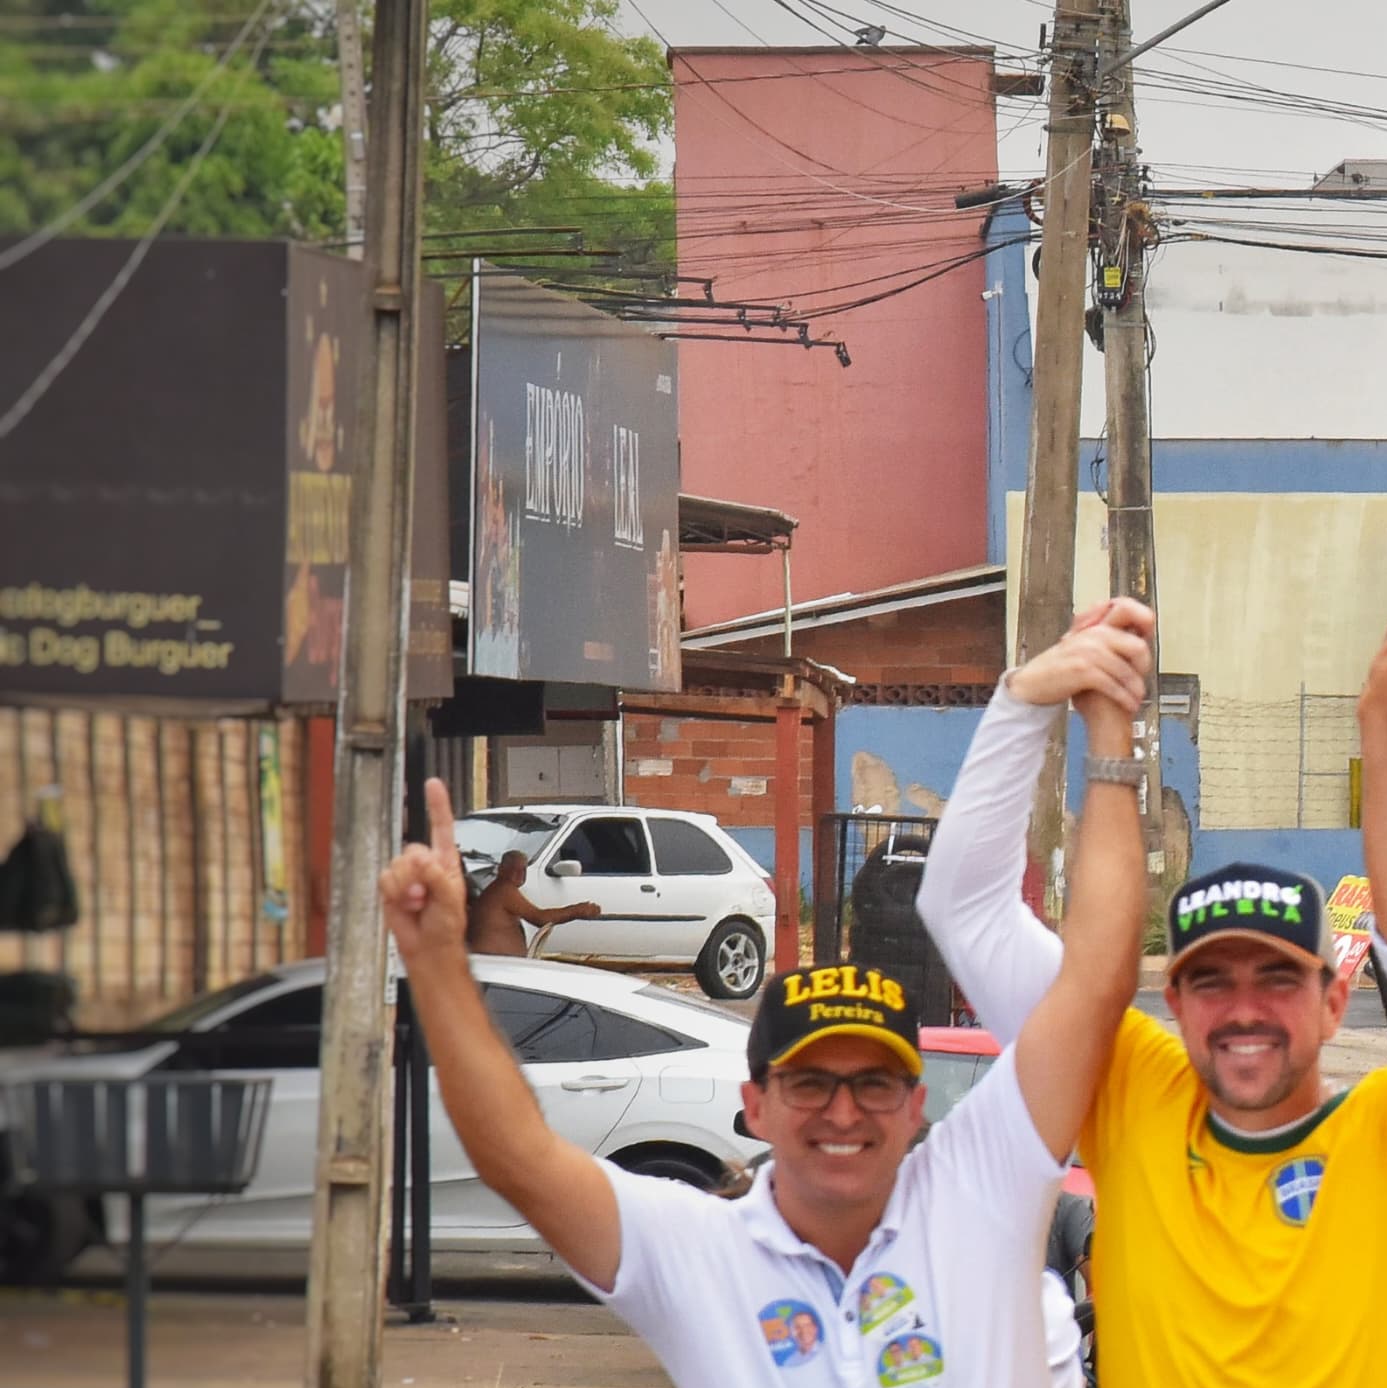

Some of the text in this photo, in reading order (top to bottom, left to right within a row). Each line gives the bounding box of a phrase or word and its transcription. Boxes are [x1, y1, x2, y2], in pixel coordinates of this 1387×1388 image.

[1178, 880, 1302, 915] LEANDRO
[1178, 898, 1303, 933] VILELA
[809, 1002, 885, 1024] Pereira
